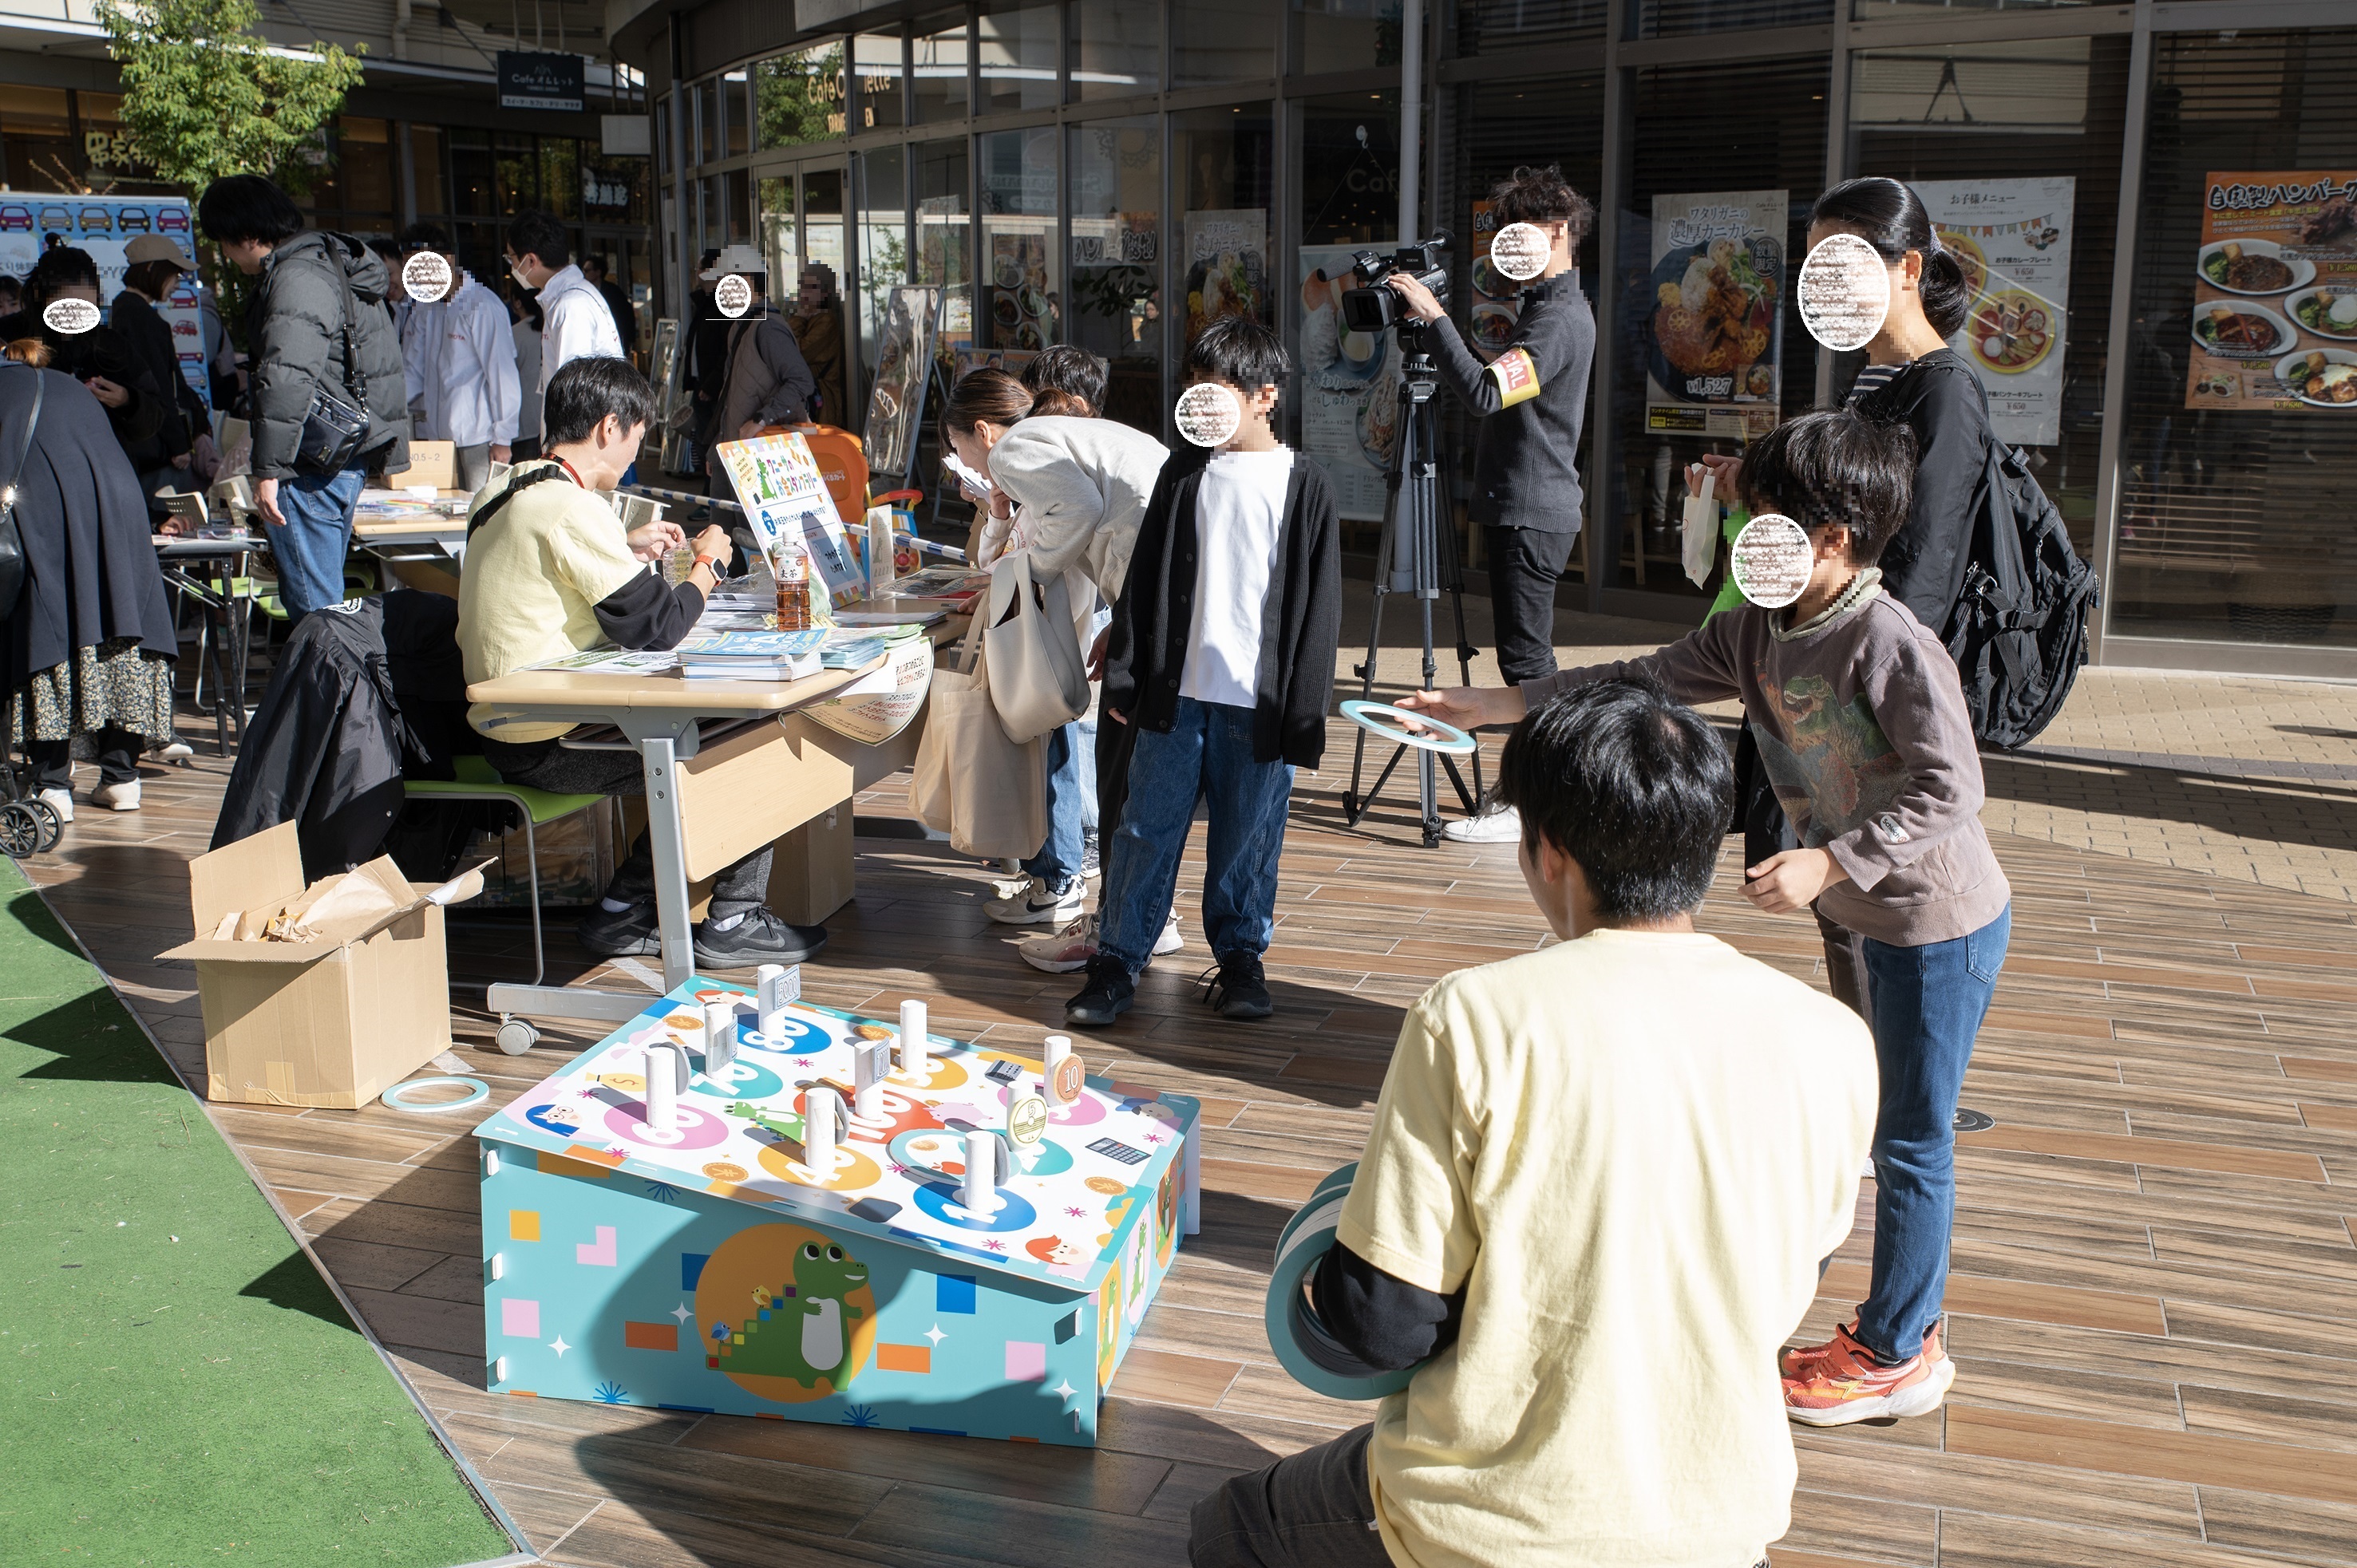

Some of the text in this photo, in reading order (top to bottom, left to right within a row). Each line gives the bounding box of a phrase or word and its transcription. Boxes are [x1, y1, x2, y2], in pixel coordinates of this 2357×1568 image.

[512, 73, 535, 84] Cafe
[808, 65, 891, 105] Cafe Olette
[1346, 168, 1398, 193] Caf
[1950, 193, 2016, 205] お子様メニュー
[1690, 207, 1749, 221] ワタリガニの
[1671, 219, 1766, 243] 濃厚カニカレー
[1754, 258, 1778, 272] 限定
[1687, 377, 1732, 396] ¥1,527
[780, 567, 797, 579] 麦茶
[1882, 818, 1900, 840] Schleich
[778, 976, 798, 1004] 5000
[1065, 1064, 1079, 1093] 10
[1027, 1101, 1036, 1117] 5
